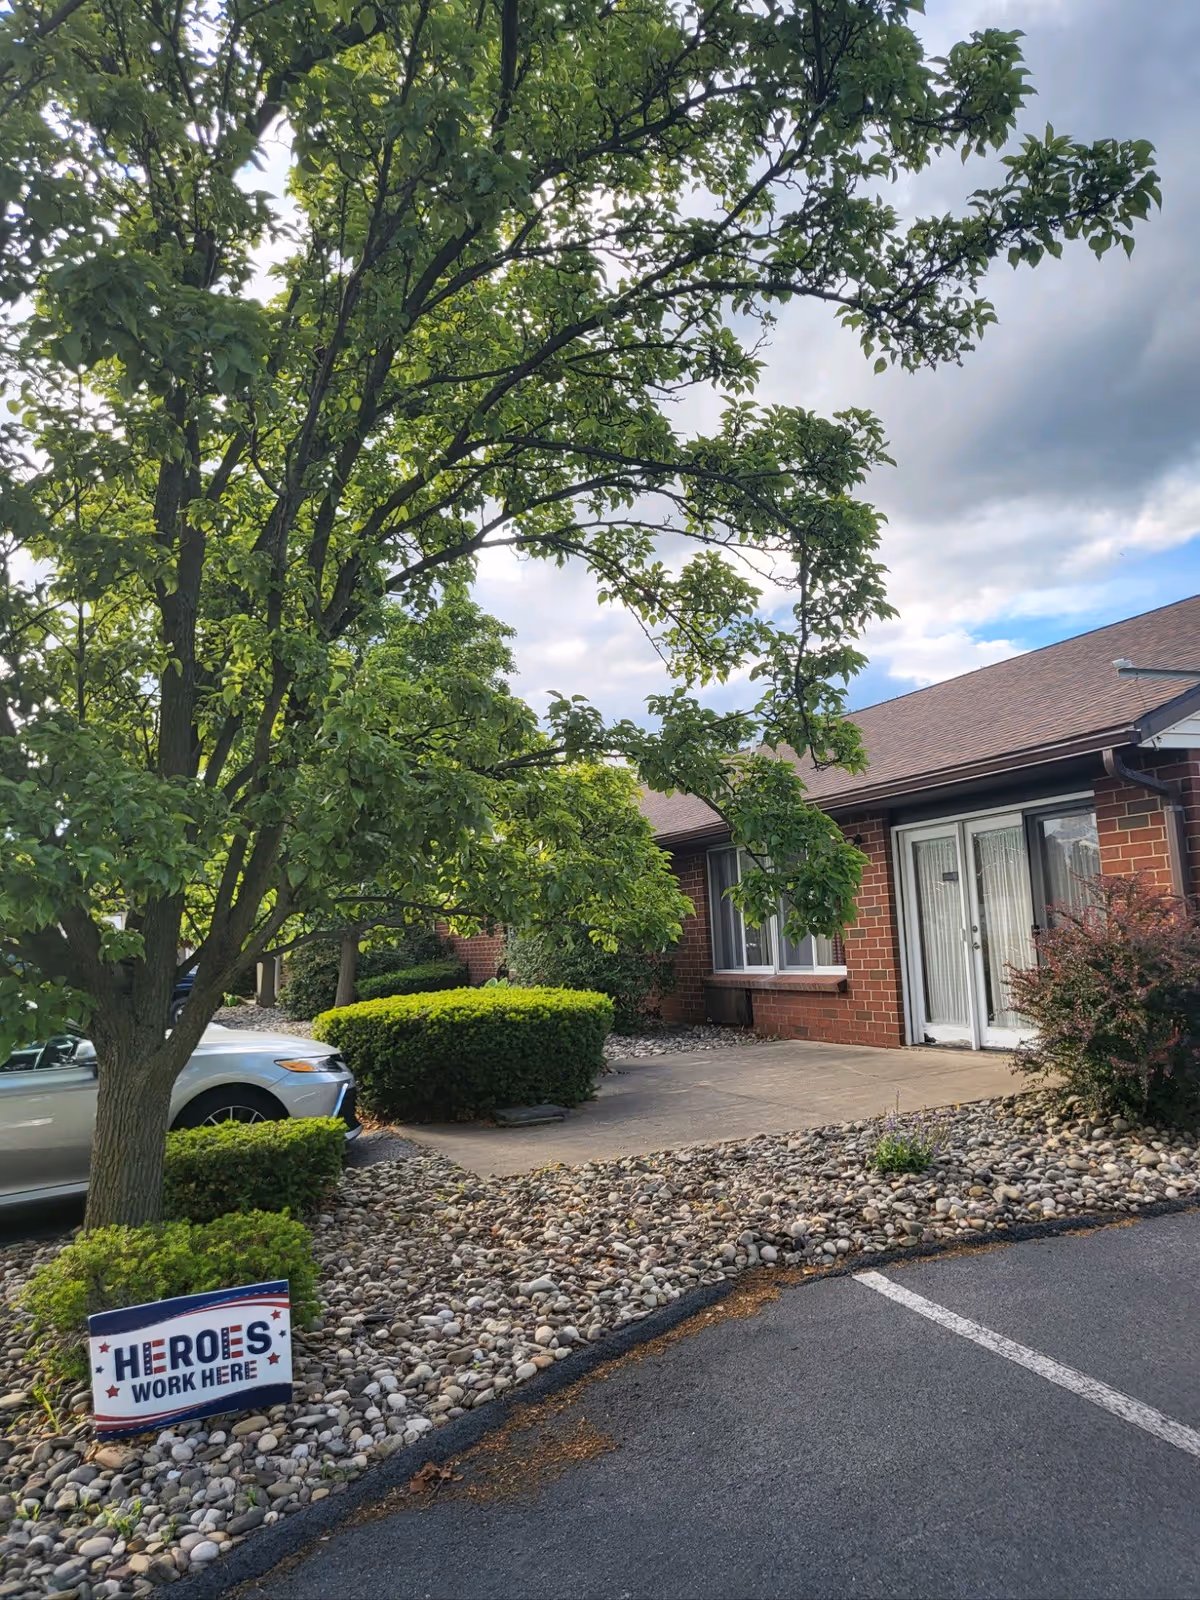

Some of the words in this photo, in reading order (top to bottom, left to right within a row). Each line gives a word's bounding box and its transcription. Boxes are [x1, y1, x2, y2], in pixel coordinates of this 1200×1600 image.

[114, 1320, 272, 1382] HEROES
[131, 1371, 196, 1404] WORK
[201, 1360, 258, 1388] HERE
